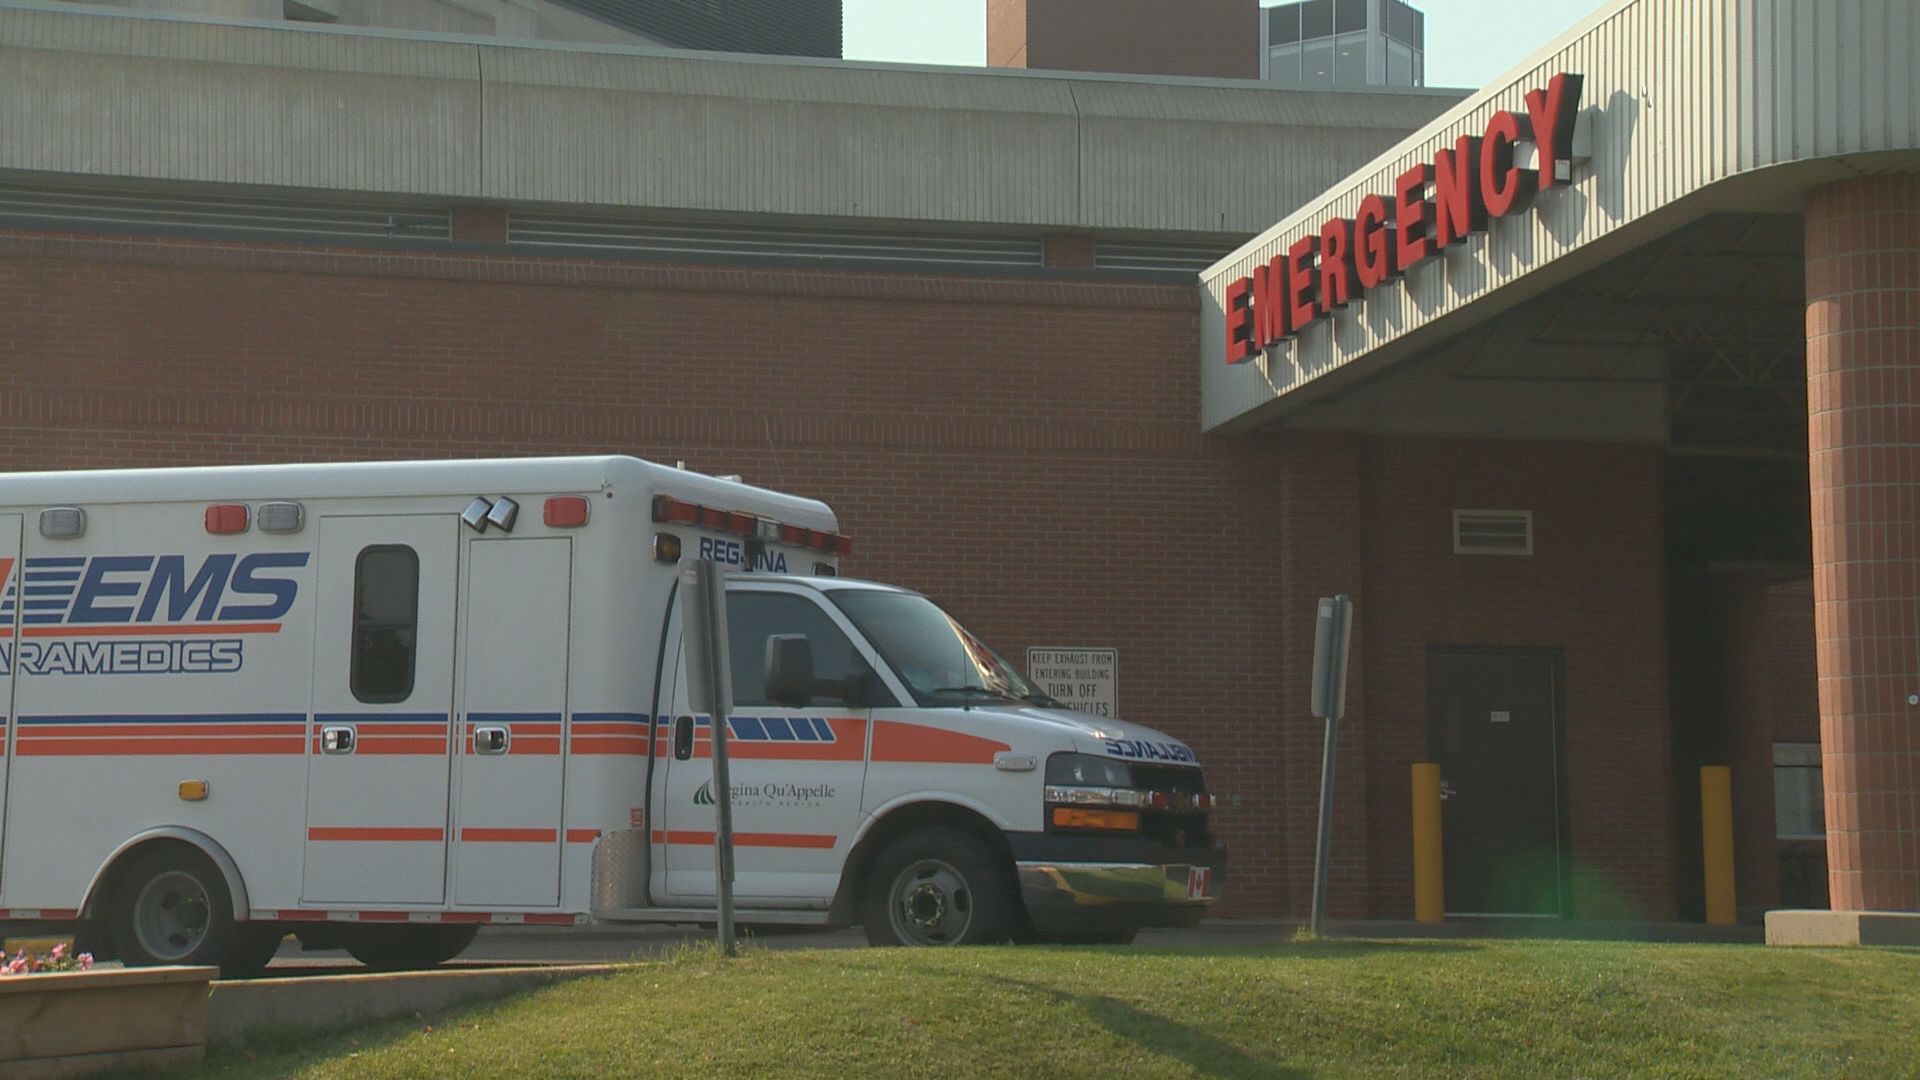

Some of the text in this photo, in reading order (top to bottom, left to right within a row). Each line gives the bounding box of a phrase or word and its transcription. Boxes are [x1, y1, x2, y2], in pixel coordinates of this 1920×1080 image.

[1226, 72, 1583, 365] EMERGENCY
[67, 552, 310, 623] EMS
[0, 639, 243, 675] RAMEDICS
[1032, 653, 1112, 665] KEEP EXHAUST FROM
[1035, 668, 1110, 680] ENTERING BUILDING
[1048, 683, 1097, 698] TURN OFF
[728, 783, 835, 800] gina Qu'Appelle
